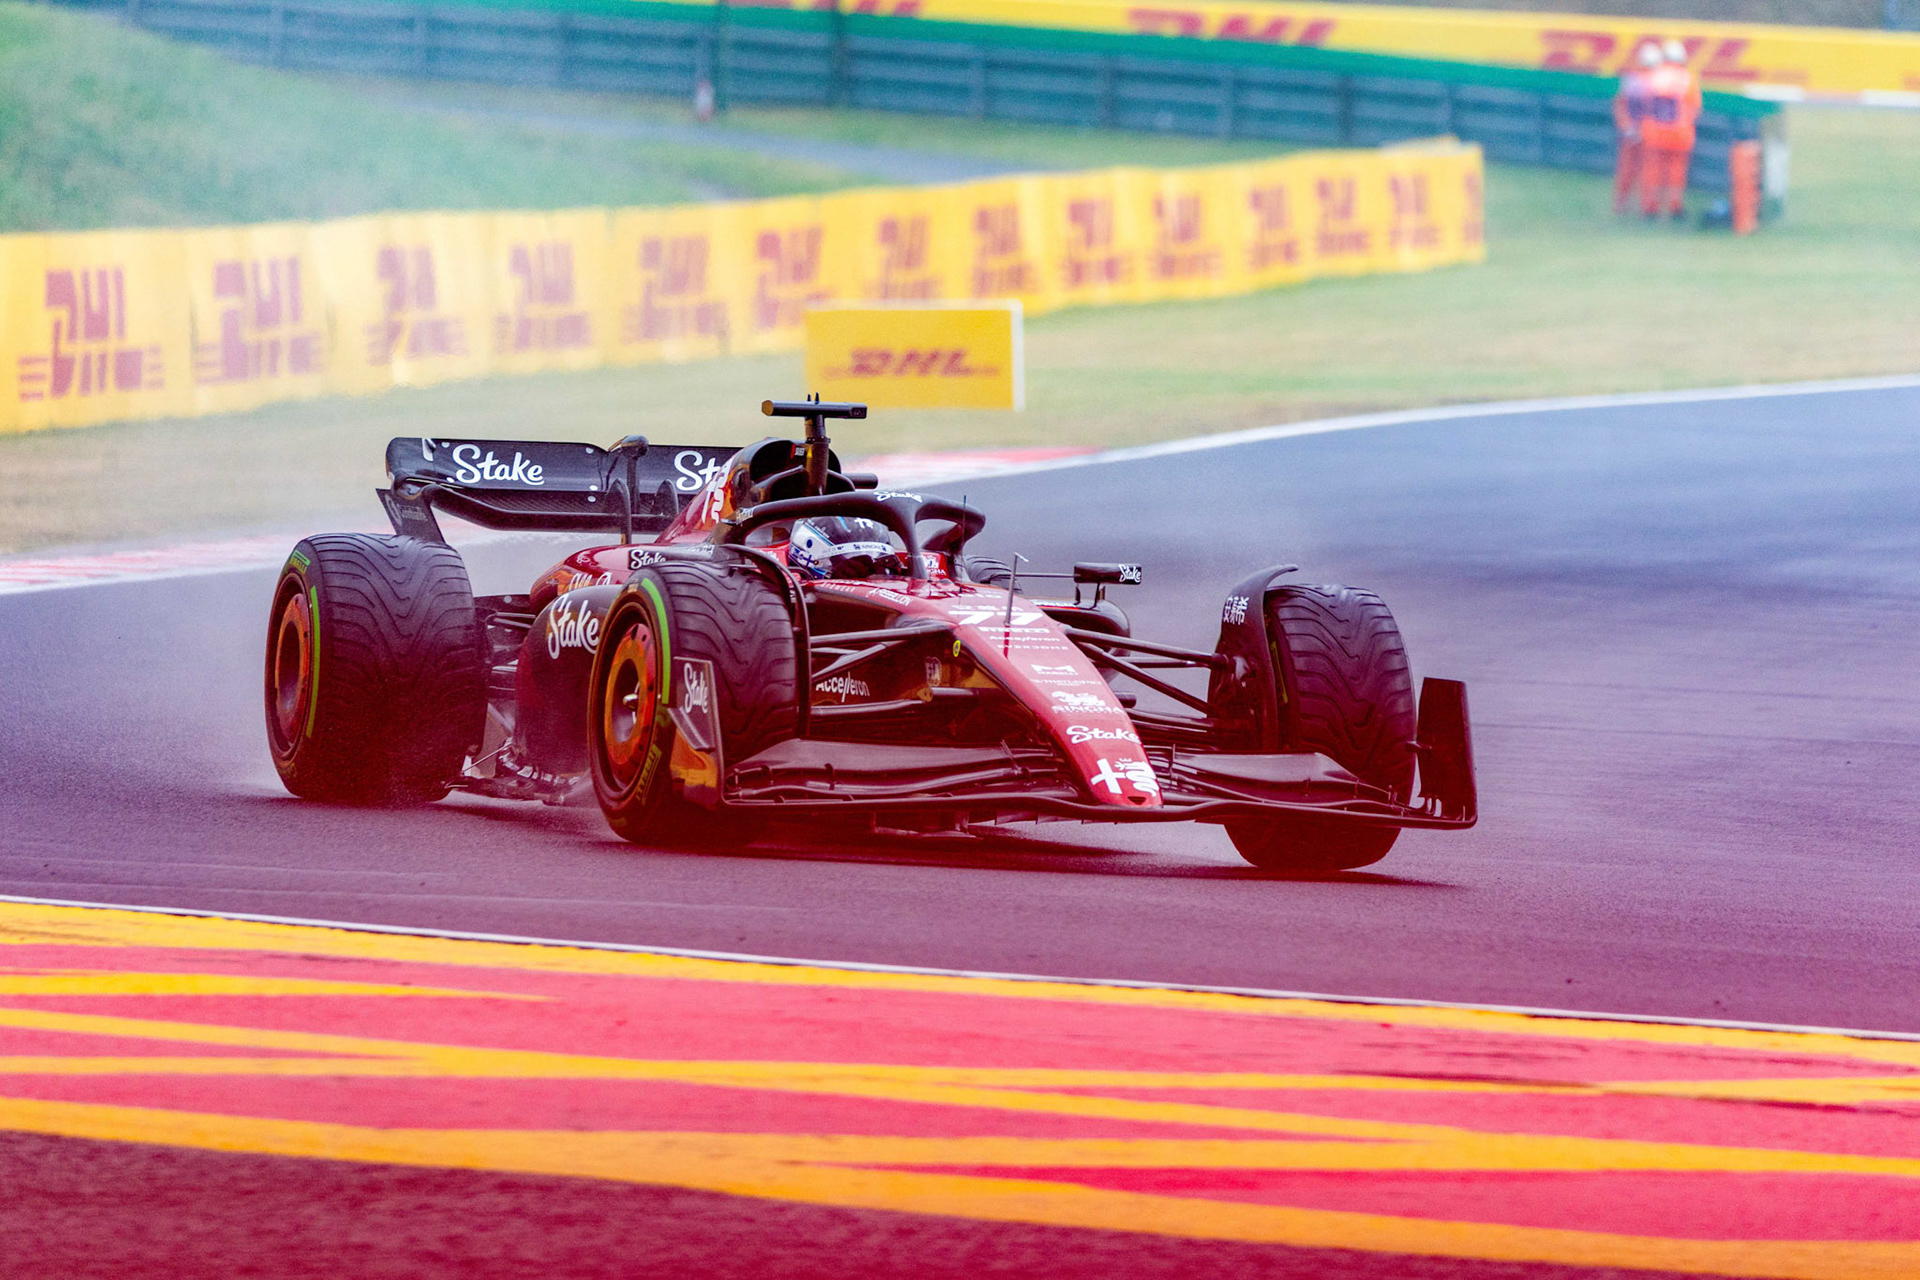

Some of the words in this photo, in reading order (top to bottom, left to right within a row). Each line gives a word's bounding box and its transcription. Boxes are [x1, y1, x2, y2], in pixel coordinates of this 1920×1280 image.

[851, 348, 970, 377] DHL
[452, 444, 545, 485] Stake
[874, 490, 923, 503] Stake
[1118, 563, 1142, 583] Stake
[548, 592, 600, 660] Stake
[948, 610, 1043, 626] 77
[683, 662, 708, 714] Stake
[815, 672, 870, 703] Accelleron
[1066, 725, 1142, 745] Stake
